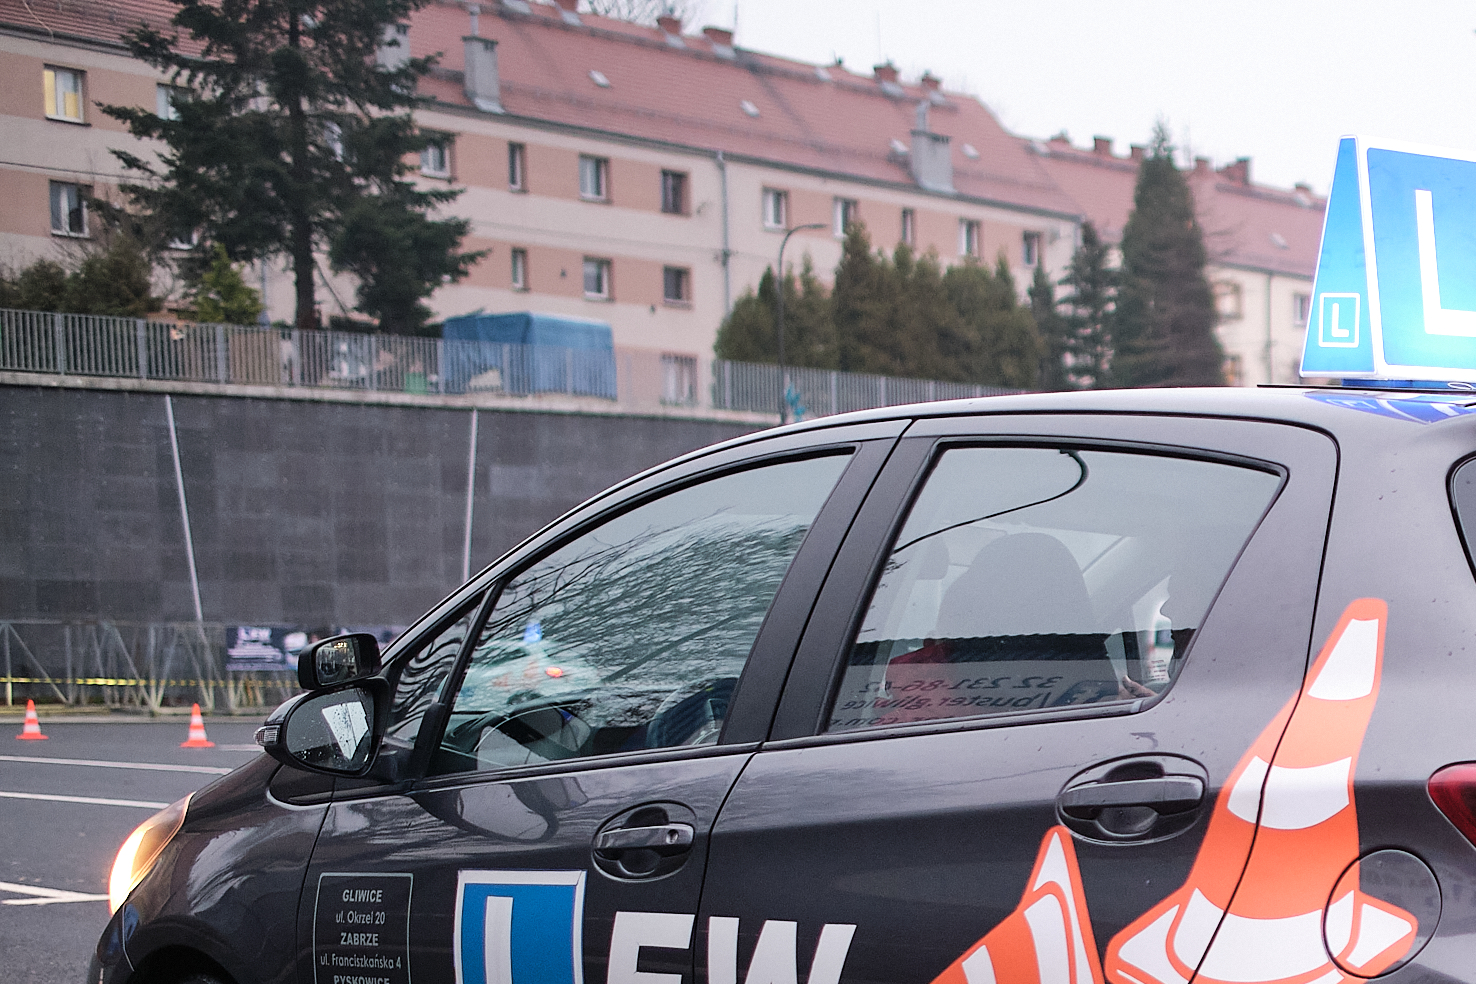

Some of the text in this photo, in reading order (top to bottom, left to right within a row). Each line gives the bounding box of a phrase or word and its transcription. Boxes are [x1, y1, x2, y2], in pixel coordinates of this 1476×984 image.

[1331, 302, 1350, 338] L
[342, 889, 383, 903] GLIWICE
[335, 910, 386, 925] ul. Okrzei 20
[340, 932, 379, 946] ZABRZE
[320, 953, 402, 970] ul. Franciszkańska 4
